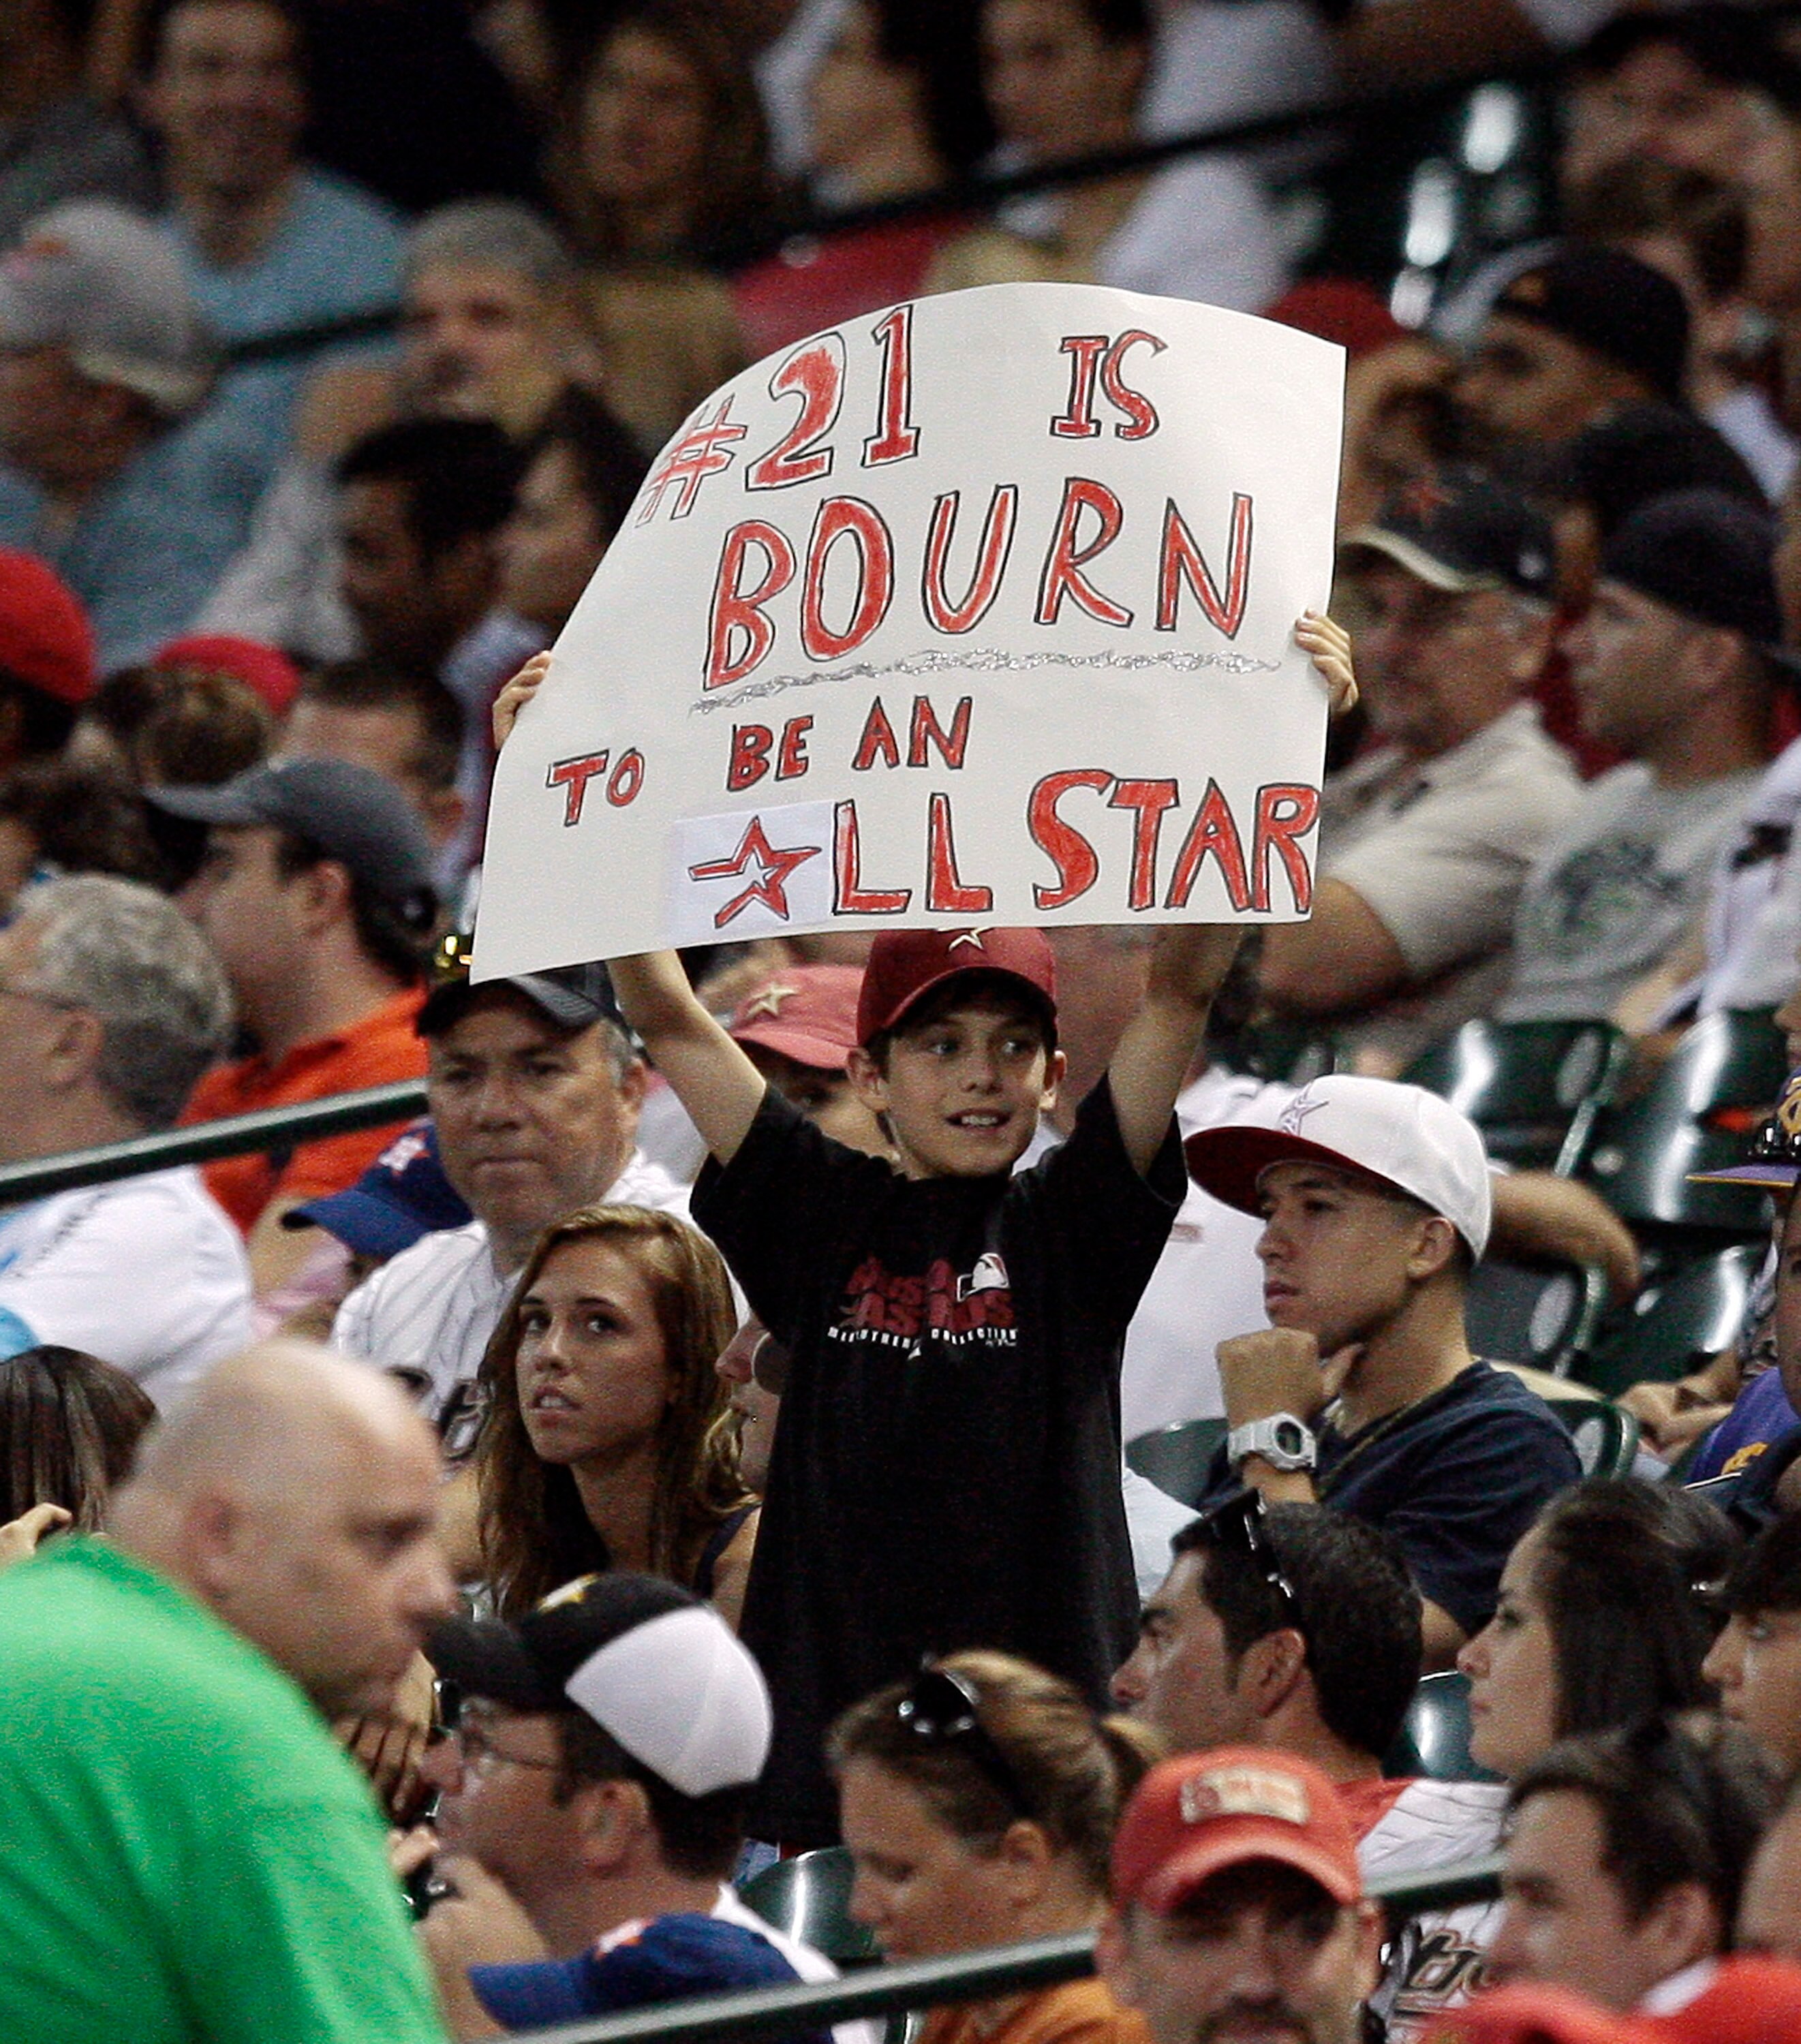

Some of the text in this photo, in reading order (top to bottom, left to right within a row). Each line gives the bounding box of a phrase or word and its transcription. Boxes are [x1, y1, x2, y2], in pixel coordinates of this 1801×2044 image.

[635, 305, 1167, 527] #21 IS
[703, 478, 1252, 690] BOURN
[547, 696, 972, 826] TO BE AN
[1026, 769, 1319, 912] STAR
